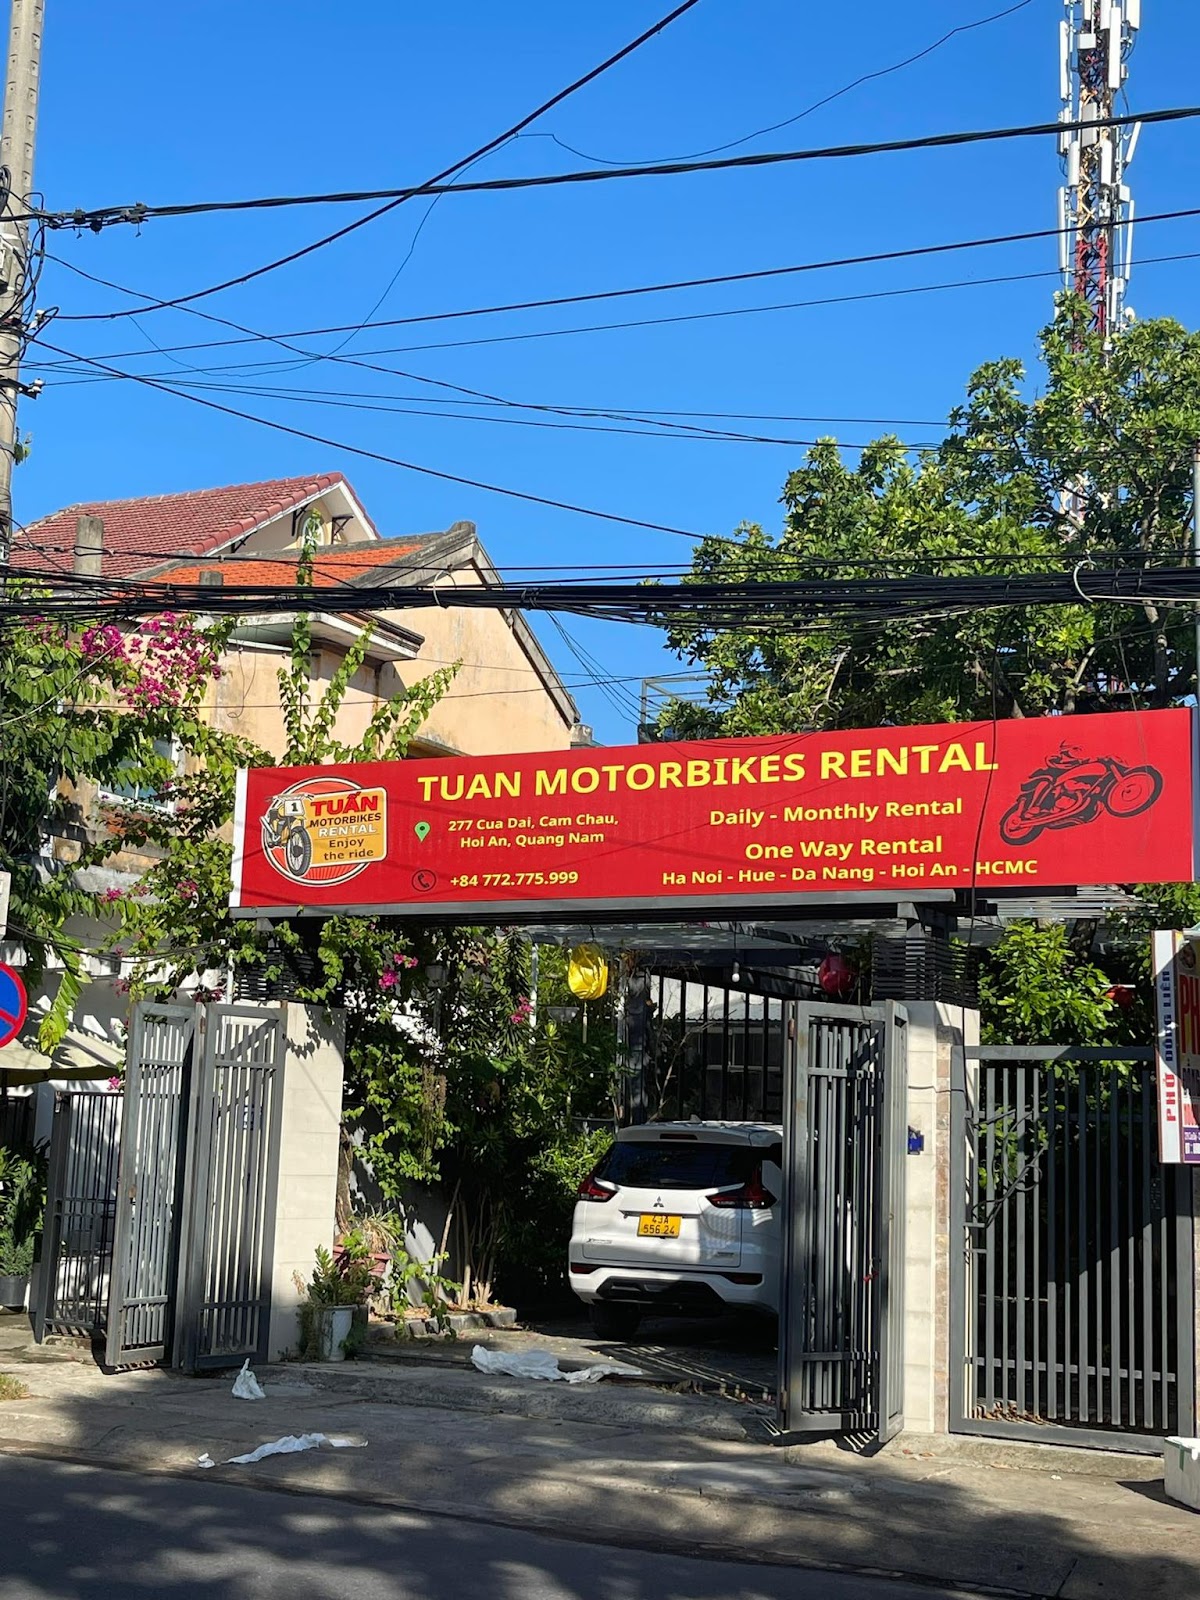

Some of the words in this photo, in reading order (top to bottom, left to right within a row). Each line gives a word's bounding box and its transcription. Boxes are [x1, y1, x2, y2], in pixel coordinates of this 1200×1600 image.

[417, 771, 522, 802] TUAN
[534, 753, 806, 797] MOTORBIKES
[820, 742, 999, 780] RENTAL
[310, 792, 378, 816] TUẤN
[709, 808, 764, 828] Daily
[783, 804, 879, 822] Monthly
[885, 797, 962, 817] Rental
[309, 813, 381, 828] MOTORBIKES
[448, 820, 473, 832] 277
[476, 819, 503, 830] Cua
[507, 817, 535, 830] Dai,
[539, 816, 572, 827] Cam
[576, 813, 618, 826] Chau,
[319, 824, 376, 837] RENTAL
[329, 838, 364, 849] Enjoy
[460, 836, 484, 848] Hoi
[488, 835, 511, 848] An,
[515, 834, 564, 847] Quang
[568, 832, 604, 844] Nam
[745, 843, 794, 859] One
[800, 841, 854, 861] Way
[860, 835, 942, 855] Rental
[324, 851, 344, 860] the
[349, 848, 374, 858] ride
[450, 874, 478, 887] +84
[482, 871, 578, 887] 772.775.999
[662, 872, 686, 885] Ha
[691, 870, 723, 883] Noi
[738, 869, 776, 882] Hue
[791, 867, 816, 881] Da
[822, 867, 874, 882] Nang
[892, 863, 924, 877] Hoi
[929, 863, 957, 876] An
[976, 860, 1037, 875] HCMC
